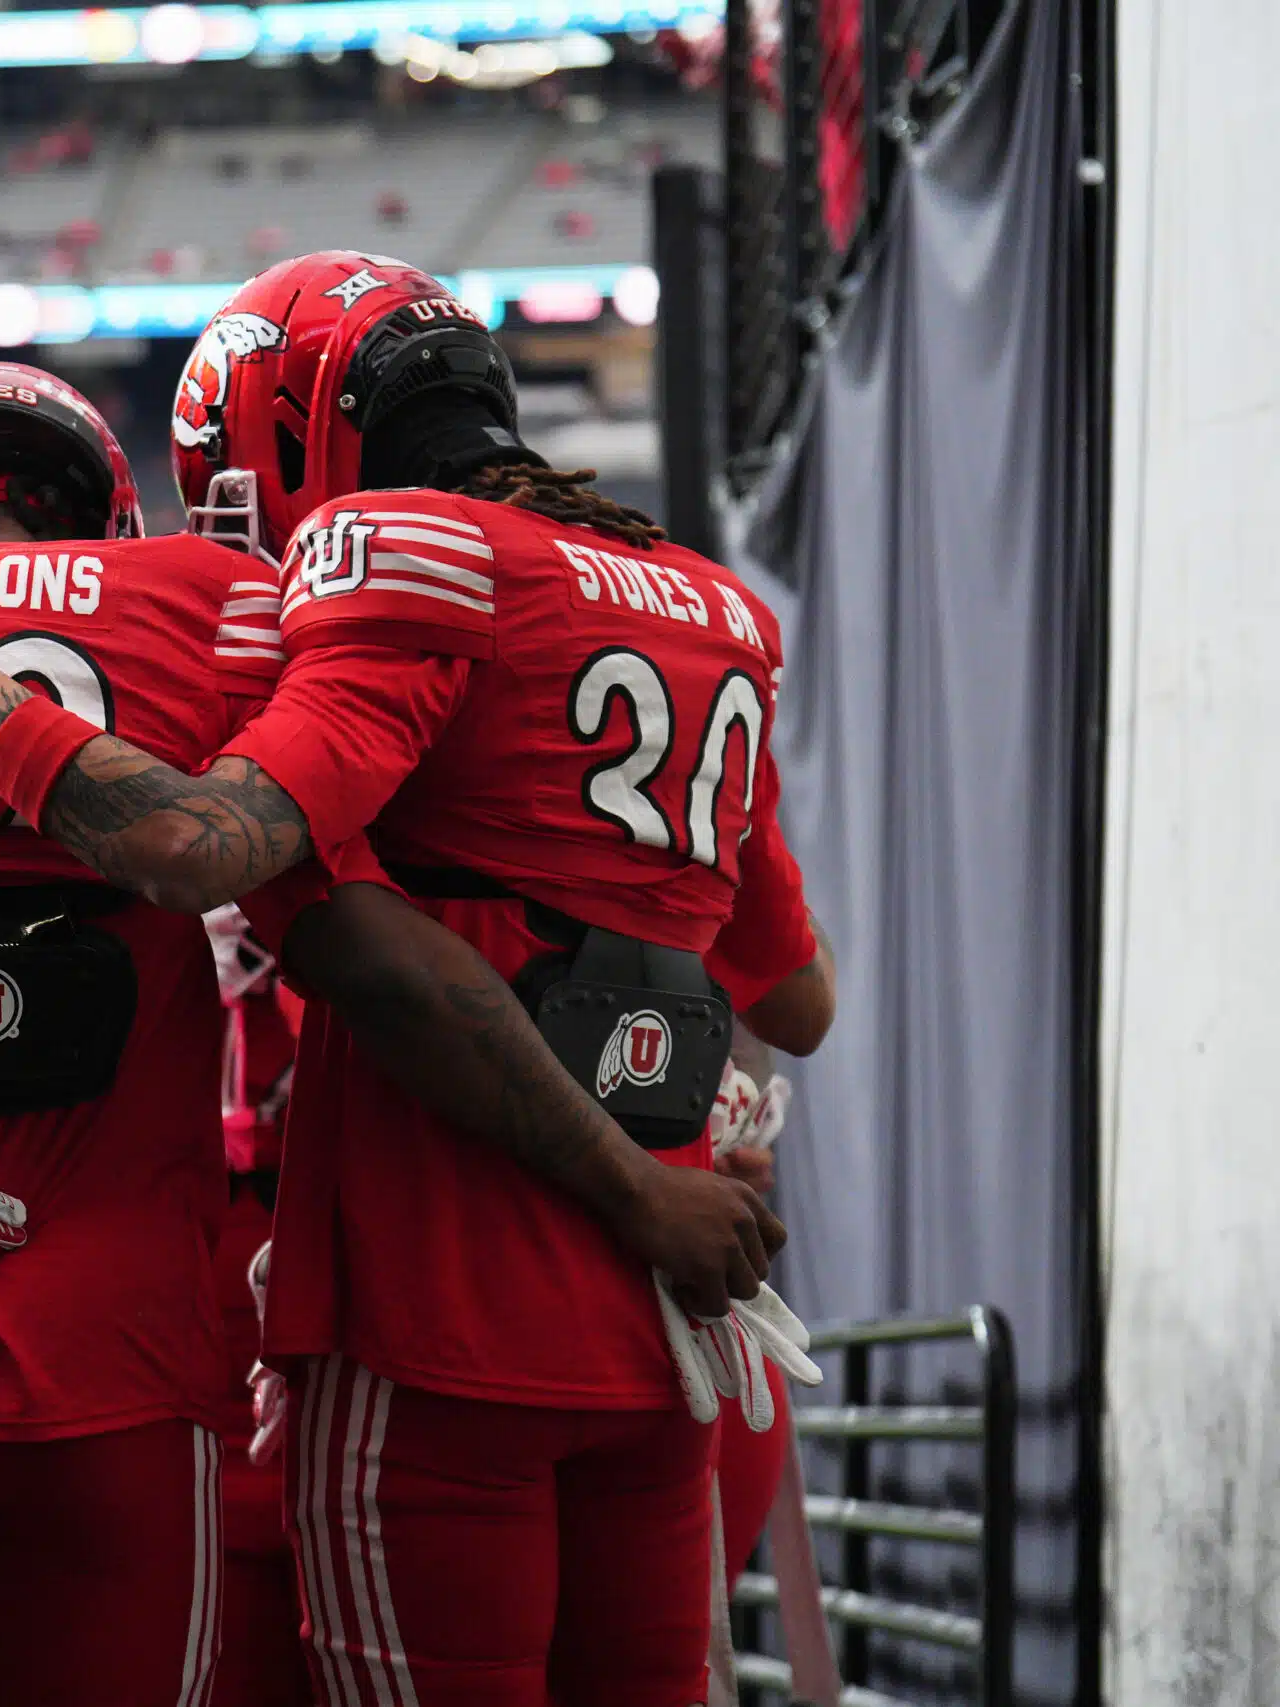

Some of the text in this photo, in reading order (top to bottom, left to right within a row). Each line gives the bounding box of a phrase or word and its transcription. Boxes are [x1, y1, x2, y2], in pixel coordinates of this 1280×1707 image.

[553, 539, 765, 652] STOKES JR
[631, 1026, 662, 1073] U
